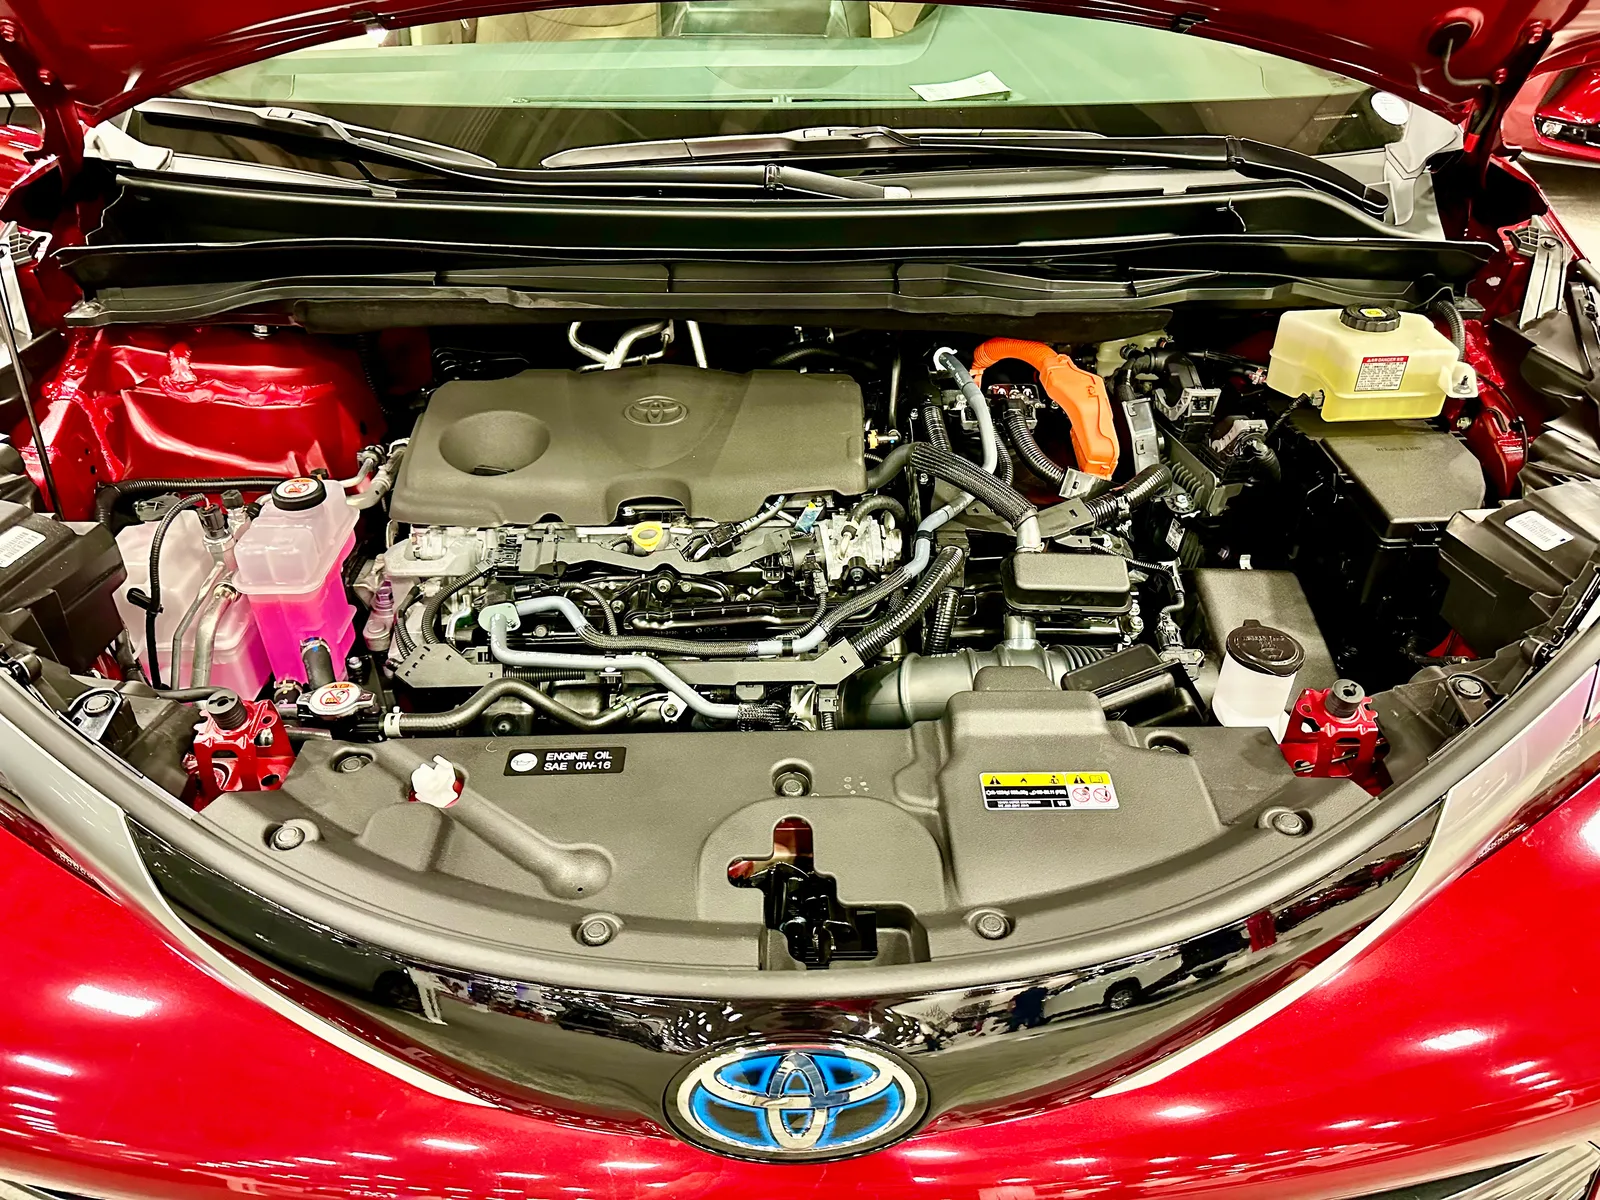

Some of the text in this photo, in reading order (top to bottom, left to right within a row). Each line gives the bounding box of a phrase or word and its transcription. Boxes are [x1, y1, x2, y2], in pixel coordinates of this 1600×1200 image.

[546, 751, 613, 761] ENGINE OIL
[543, 761, 612, 771] SAE 0W-16
